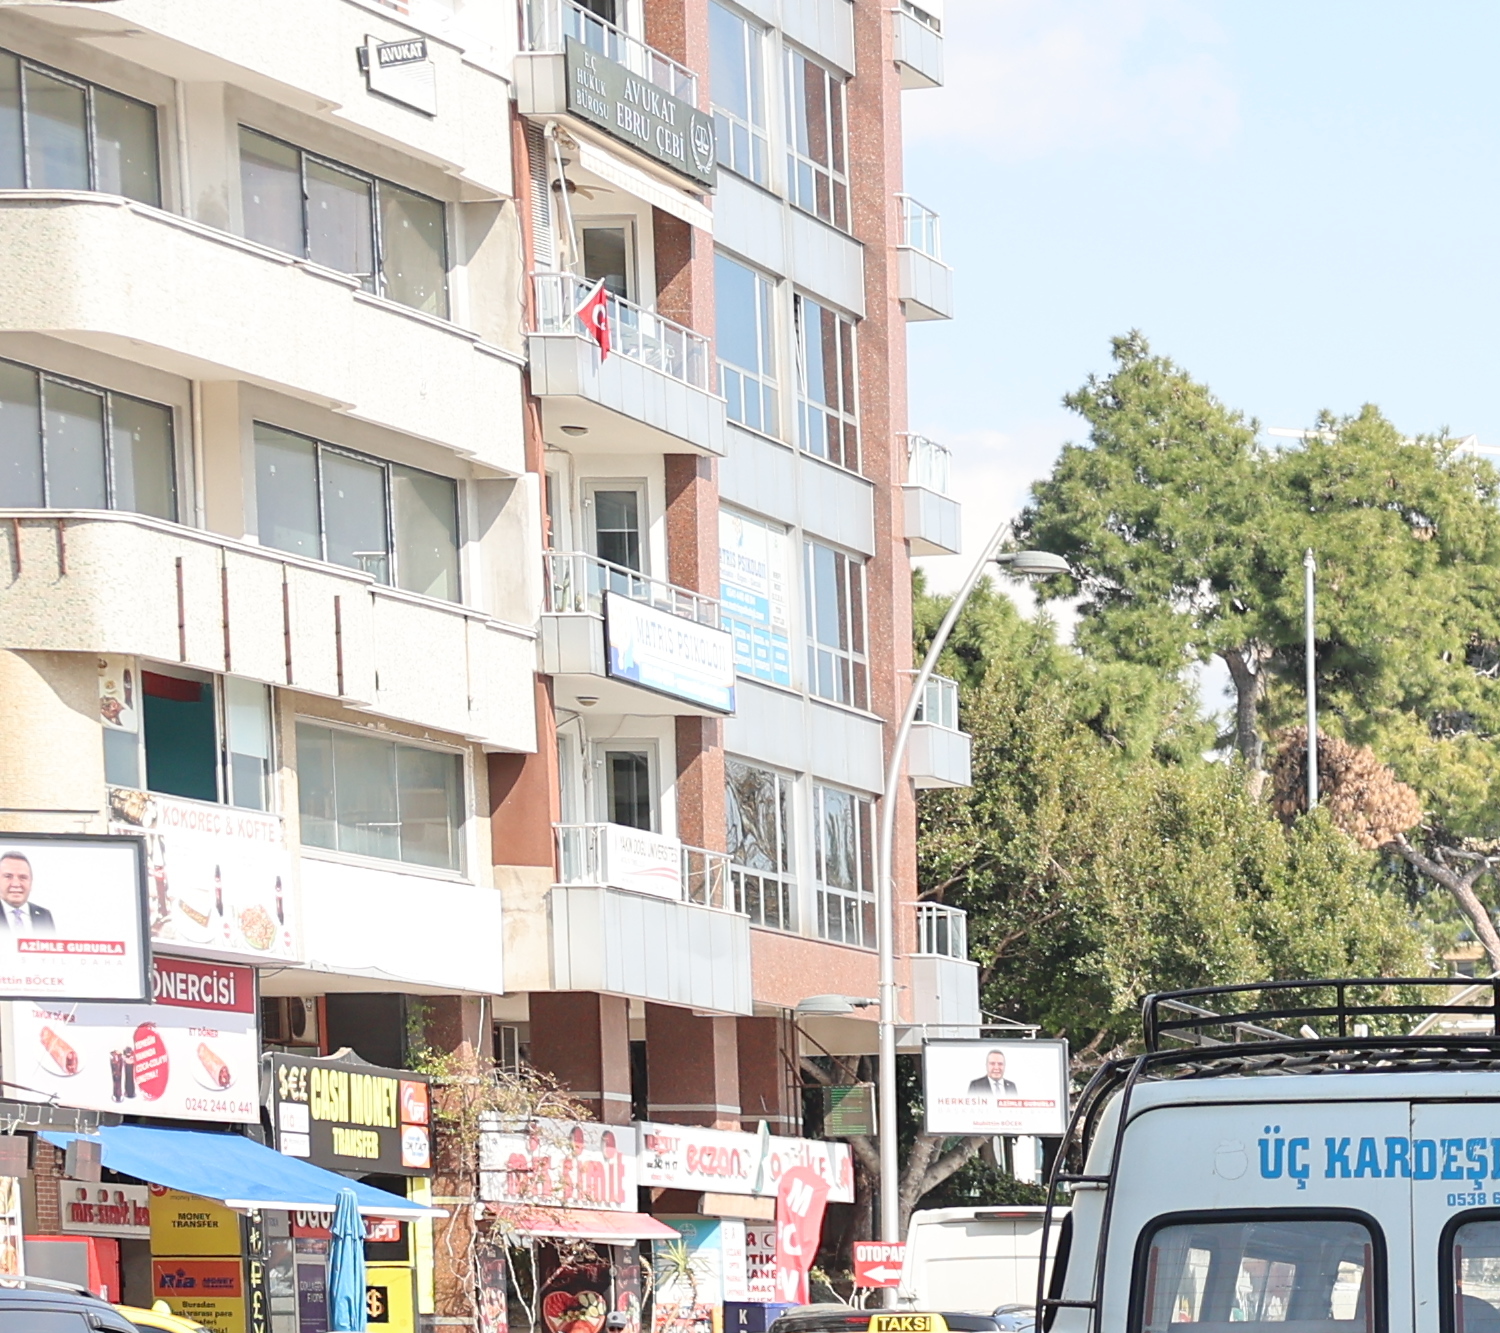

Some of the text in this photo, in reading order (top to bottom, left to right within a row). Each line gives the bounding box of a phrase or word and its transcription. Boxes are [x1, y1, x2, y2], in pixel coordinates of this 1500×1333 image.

[380, 42, 423, 64] AVUKAT
[576, 67, 606, 97] HUKUK
[575, 87, 609, 120] BÜROSU
[623, 77, 676, 126] AVUKAT
[616, 101, 686, 162] EBRU ÇEBİ
[162, 804, 221, 836] KOKOREÇ
[19, 940, 123, 955] AZİMLE GURURLA
[25, 972, 64, 987] BÖCEK
[185, 1098, 208, 1112] 0242
[211, 1099, 226, 1113] 244
[238, 1102, 253, 1115] 441
[310, 1067, 398, 1129] CASH MONEY
[938, 1096, 988, 1106] HERKESİN
[332, 1127, 379, 1160] TRANSFER
[1257, 1125, 1310, 1190] ÜÇ
[1446, 1193, 1487, 1207] 0538
[171, 1220, 219, 1229] TRANSFER
[178, 1212, 211, 1221] MONEY
[159, 1267, 196, 1288] Ria
